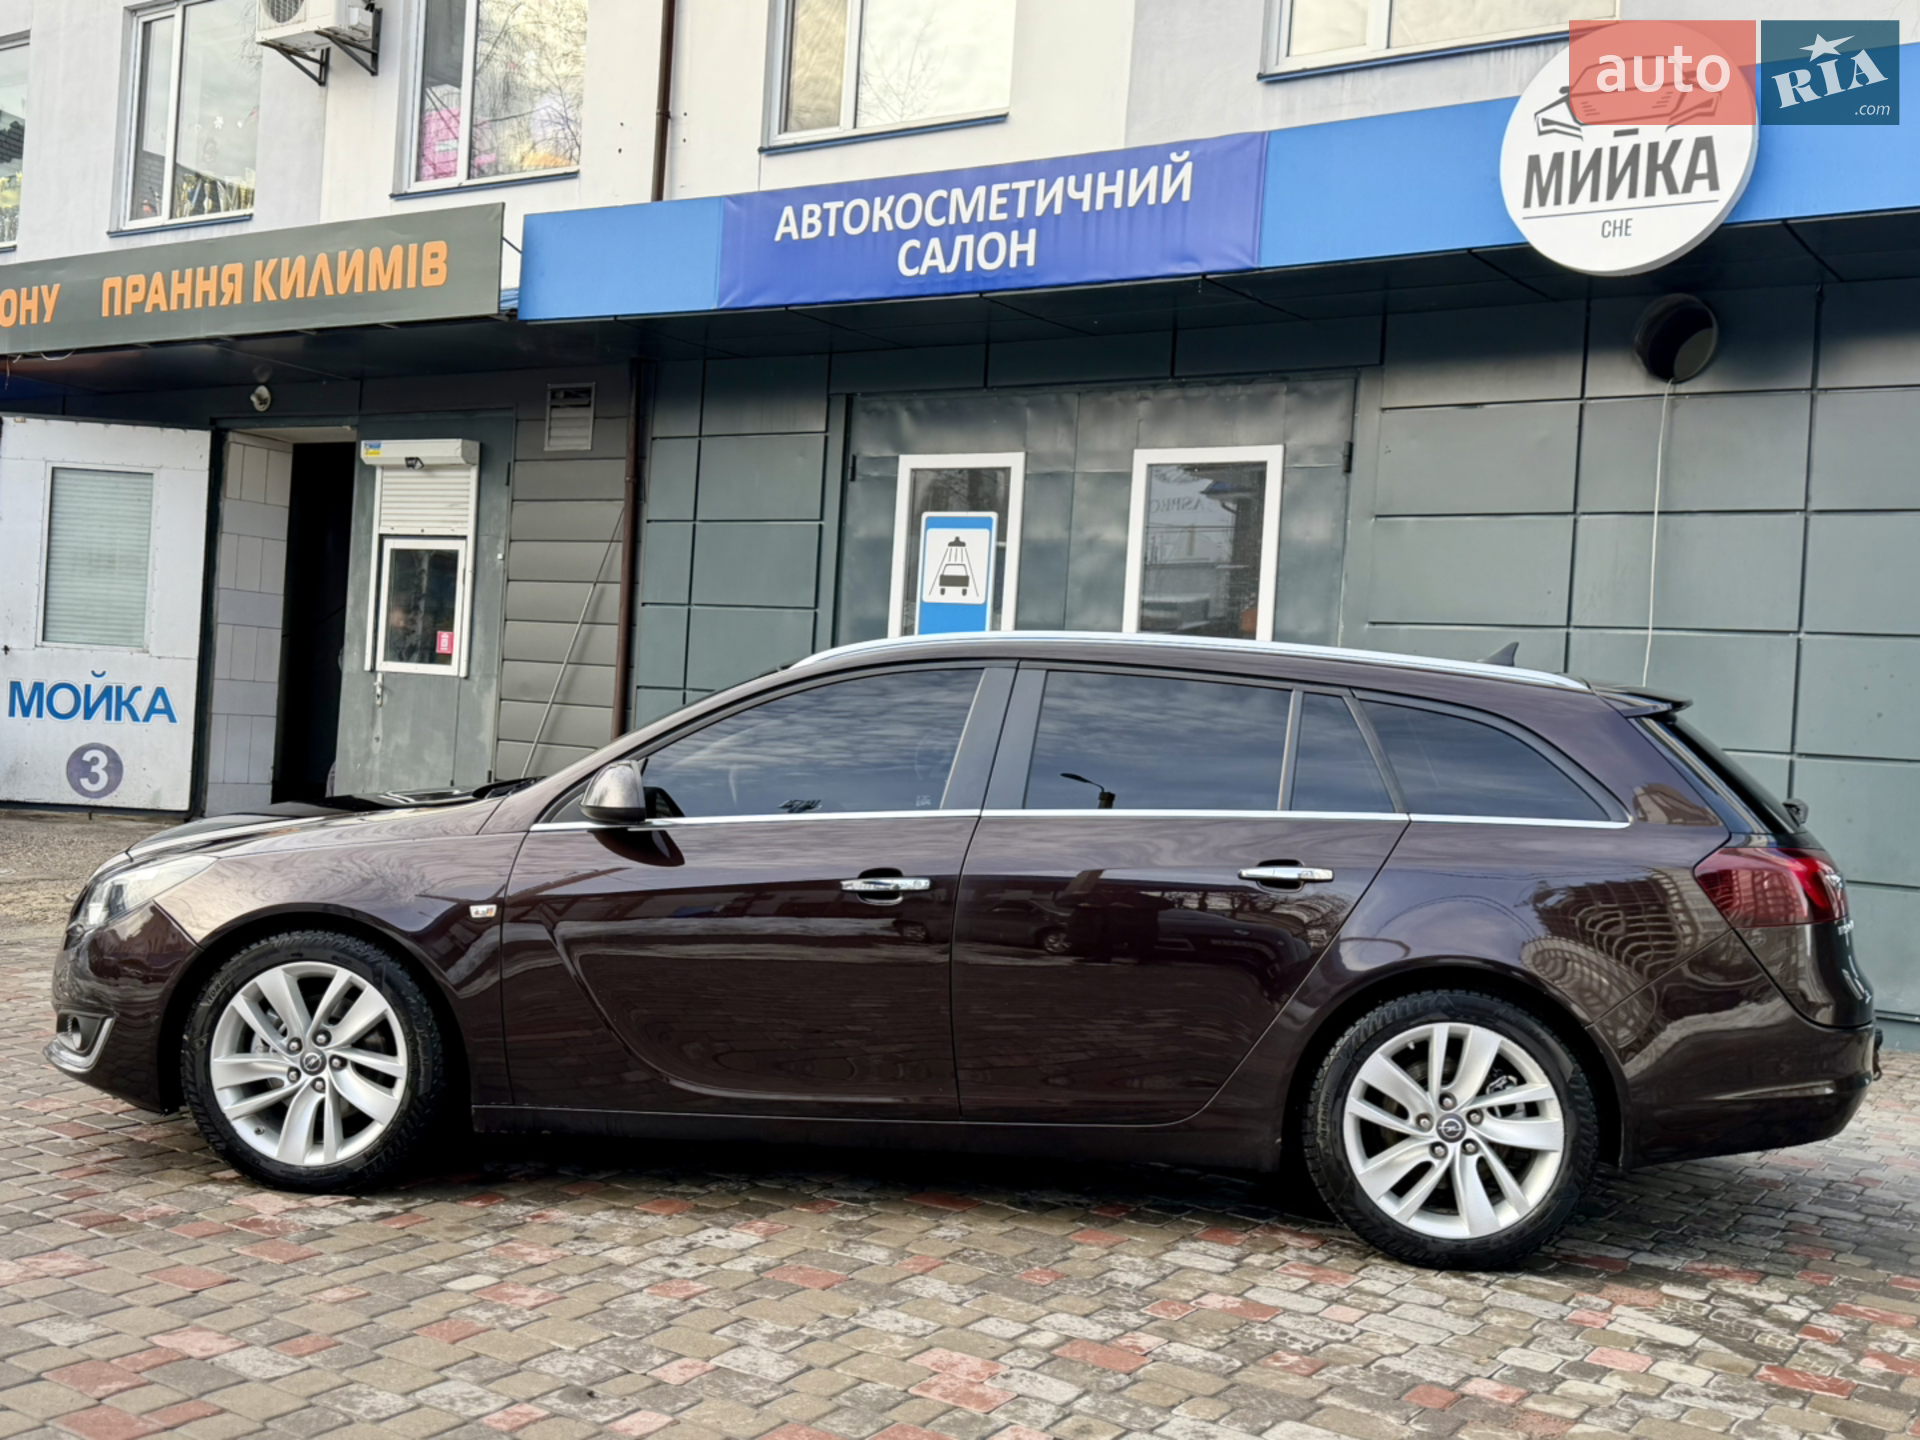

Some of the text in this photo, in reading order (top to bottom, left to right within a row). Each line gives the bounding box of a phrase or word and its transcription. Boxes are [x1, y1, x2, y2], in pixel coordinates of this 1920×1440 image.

[774, 150, 1193, 241] АВТОКОСМЕТИЧНИЙ
[1522, 128, 1720, 209] МИЙКА
[101, 262, 243, 318] ПРАННЯ
[253, 240, 448, 303] КИЛИМІВ
[897, 228, 1037, 277] САЛОН
[8, 670, 178, 724] МОЙКА
[79, 748, 109, 793] 3
